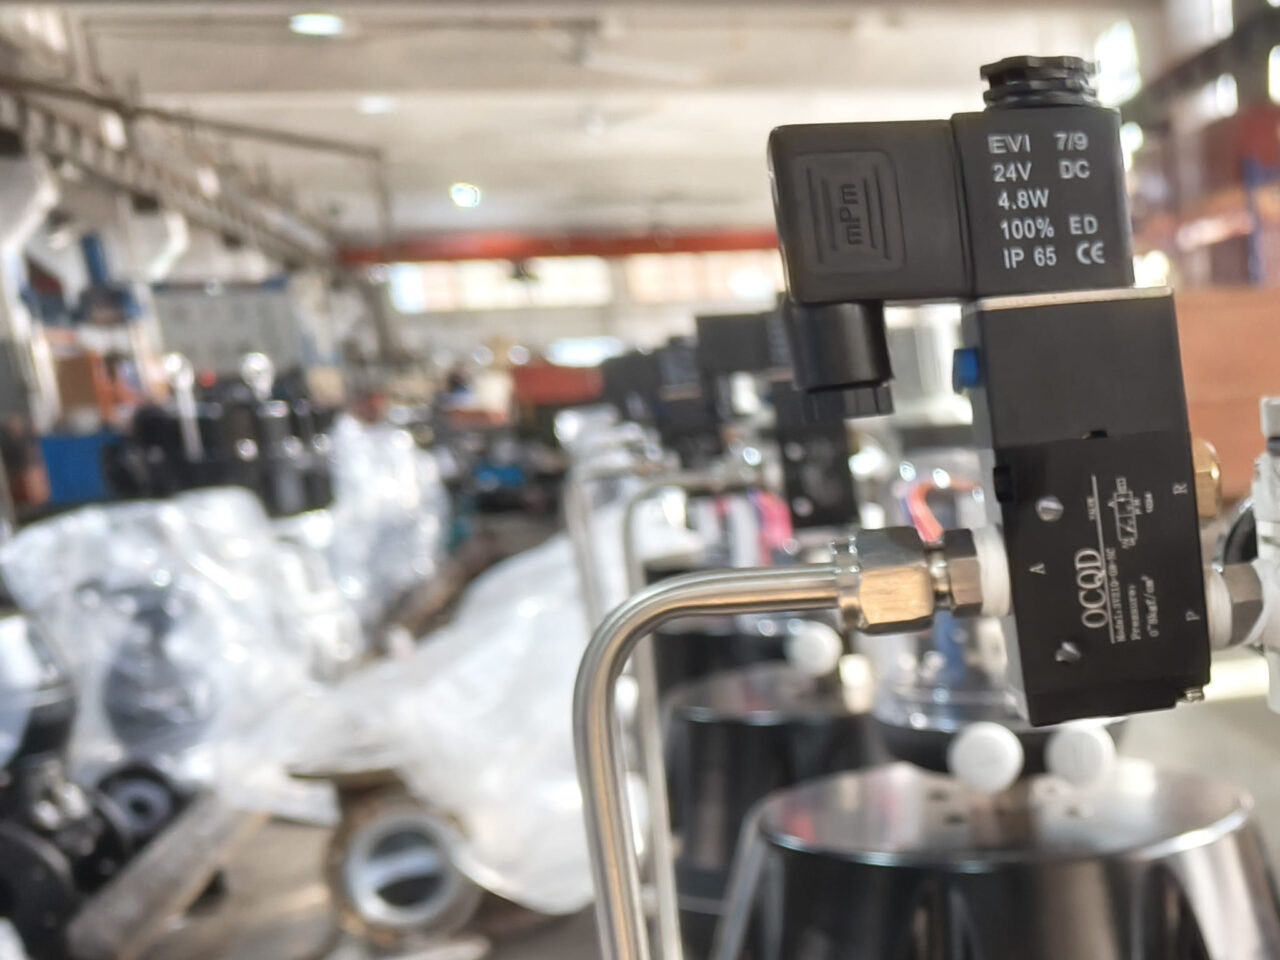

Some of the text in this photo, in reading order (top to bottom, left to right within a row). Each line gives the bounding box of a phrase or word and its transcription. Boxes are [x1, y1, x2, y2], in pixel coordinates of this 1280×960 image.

[1054, 132, 1089, 151] 7/9
[993, 160, 1090, 182] 24V DC
[998, 189, 1049, 210] 4.8W
[1000, 216, 1098, 239] 100% ED
[1003, 246, 1057, 269] IP 65
[1172, 481, 1188, 495] R
[1029, 563, 1046, 575] A
[1075, 549, 1108, 628] OCQD
[1186, 610, 1200, 622] P
